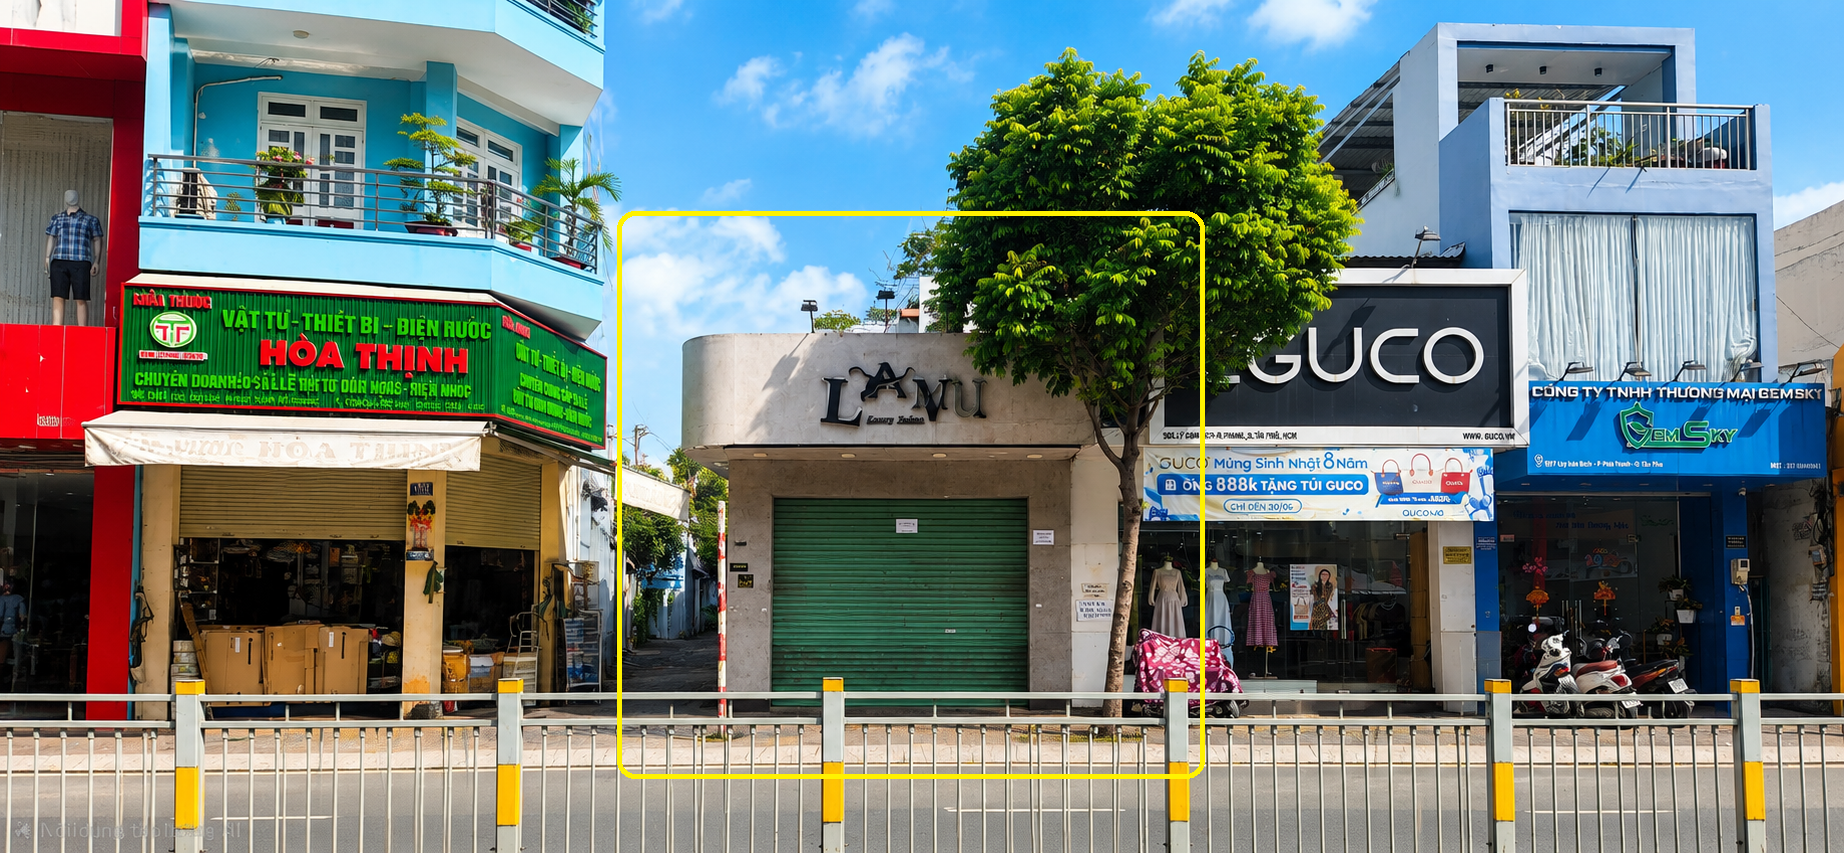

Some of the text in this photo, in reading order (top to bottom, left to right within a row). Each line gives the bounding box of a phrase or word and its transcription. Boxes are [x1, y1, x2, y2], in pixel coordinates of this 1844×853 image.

[260, 332, 468, 378] HÒA THỊNH
[1205, 327, 1485, 385] GUCO
[1582, 386, 1603, 398] TY
[1606, 387, 1652, 398] TNHH
[1255, 457, 1285, 469] Sinh
[1322, 451, 1335, 470] 8
[1326, 480, 1364, 491] GUCO
